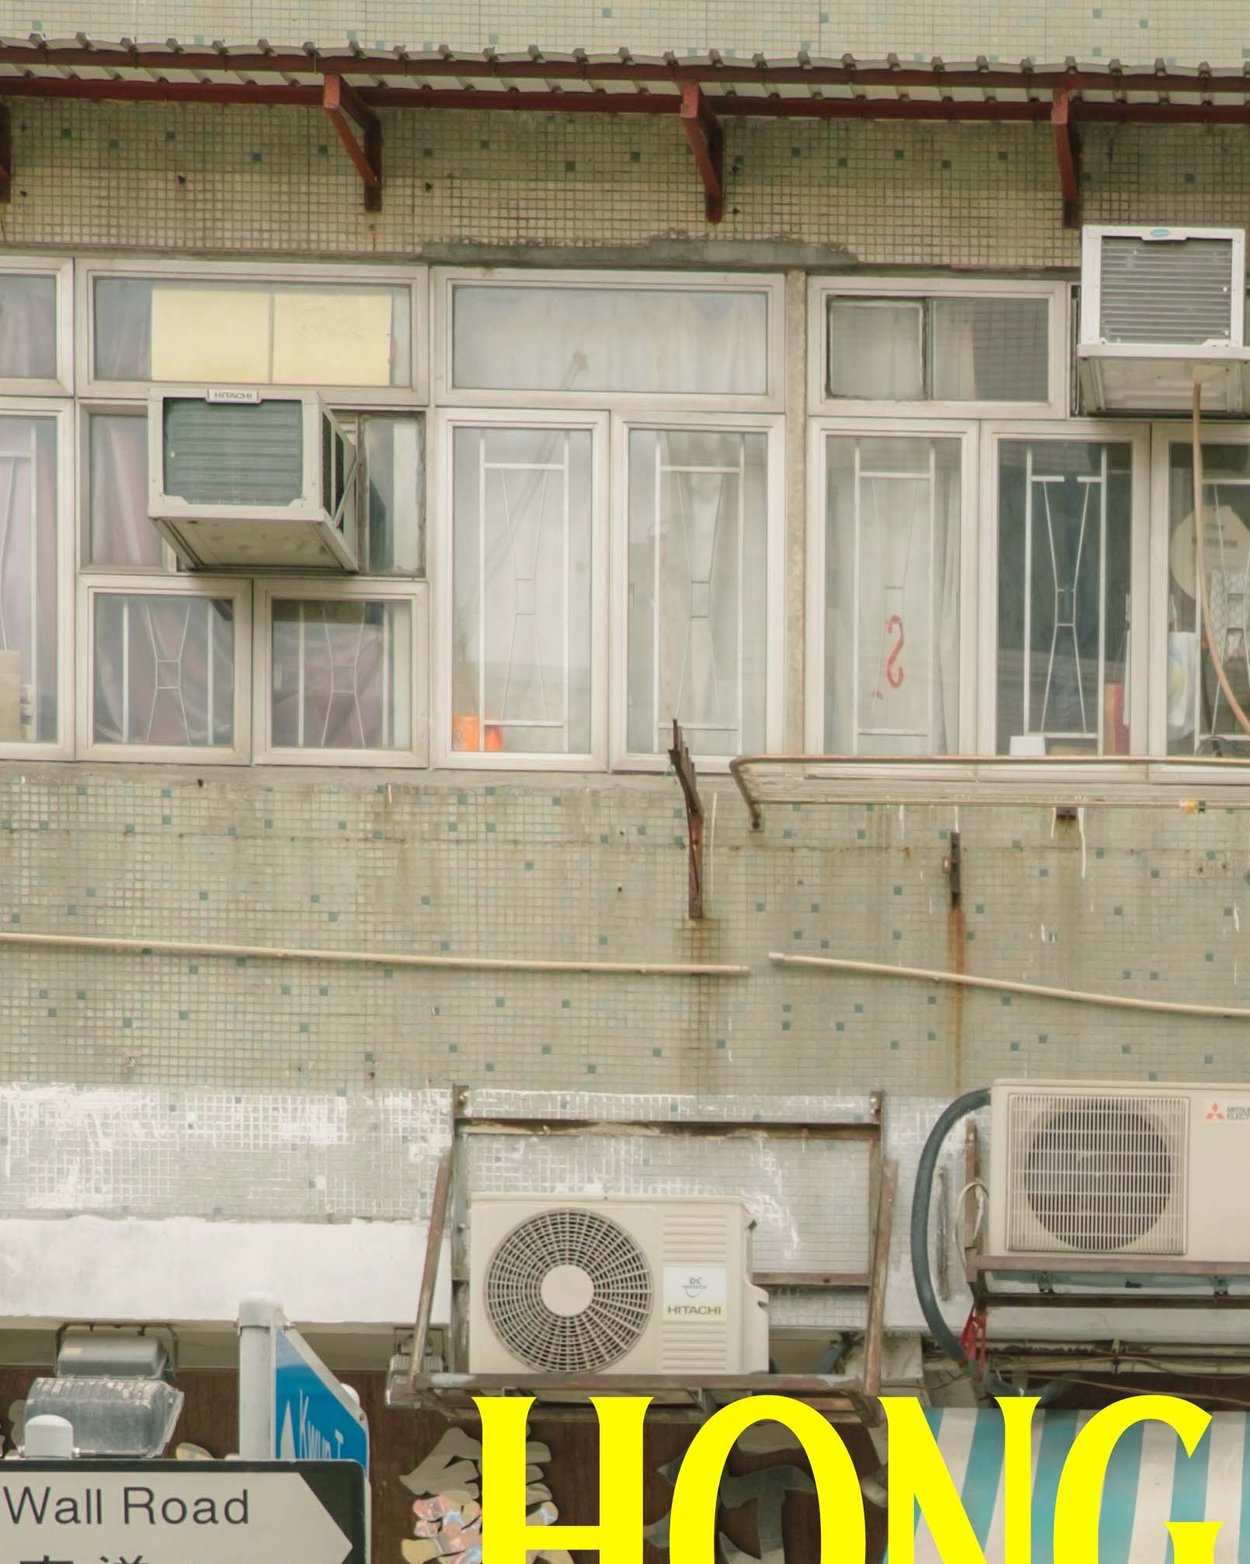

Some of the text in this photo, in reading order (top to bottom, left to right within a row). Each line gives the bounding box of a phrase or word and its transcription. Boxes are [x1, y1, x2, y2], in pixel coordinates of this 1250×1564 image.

[667, 1305, 721, 1315] HITACHI
[3, 1485, 249, 1525] Wall Road
